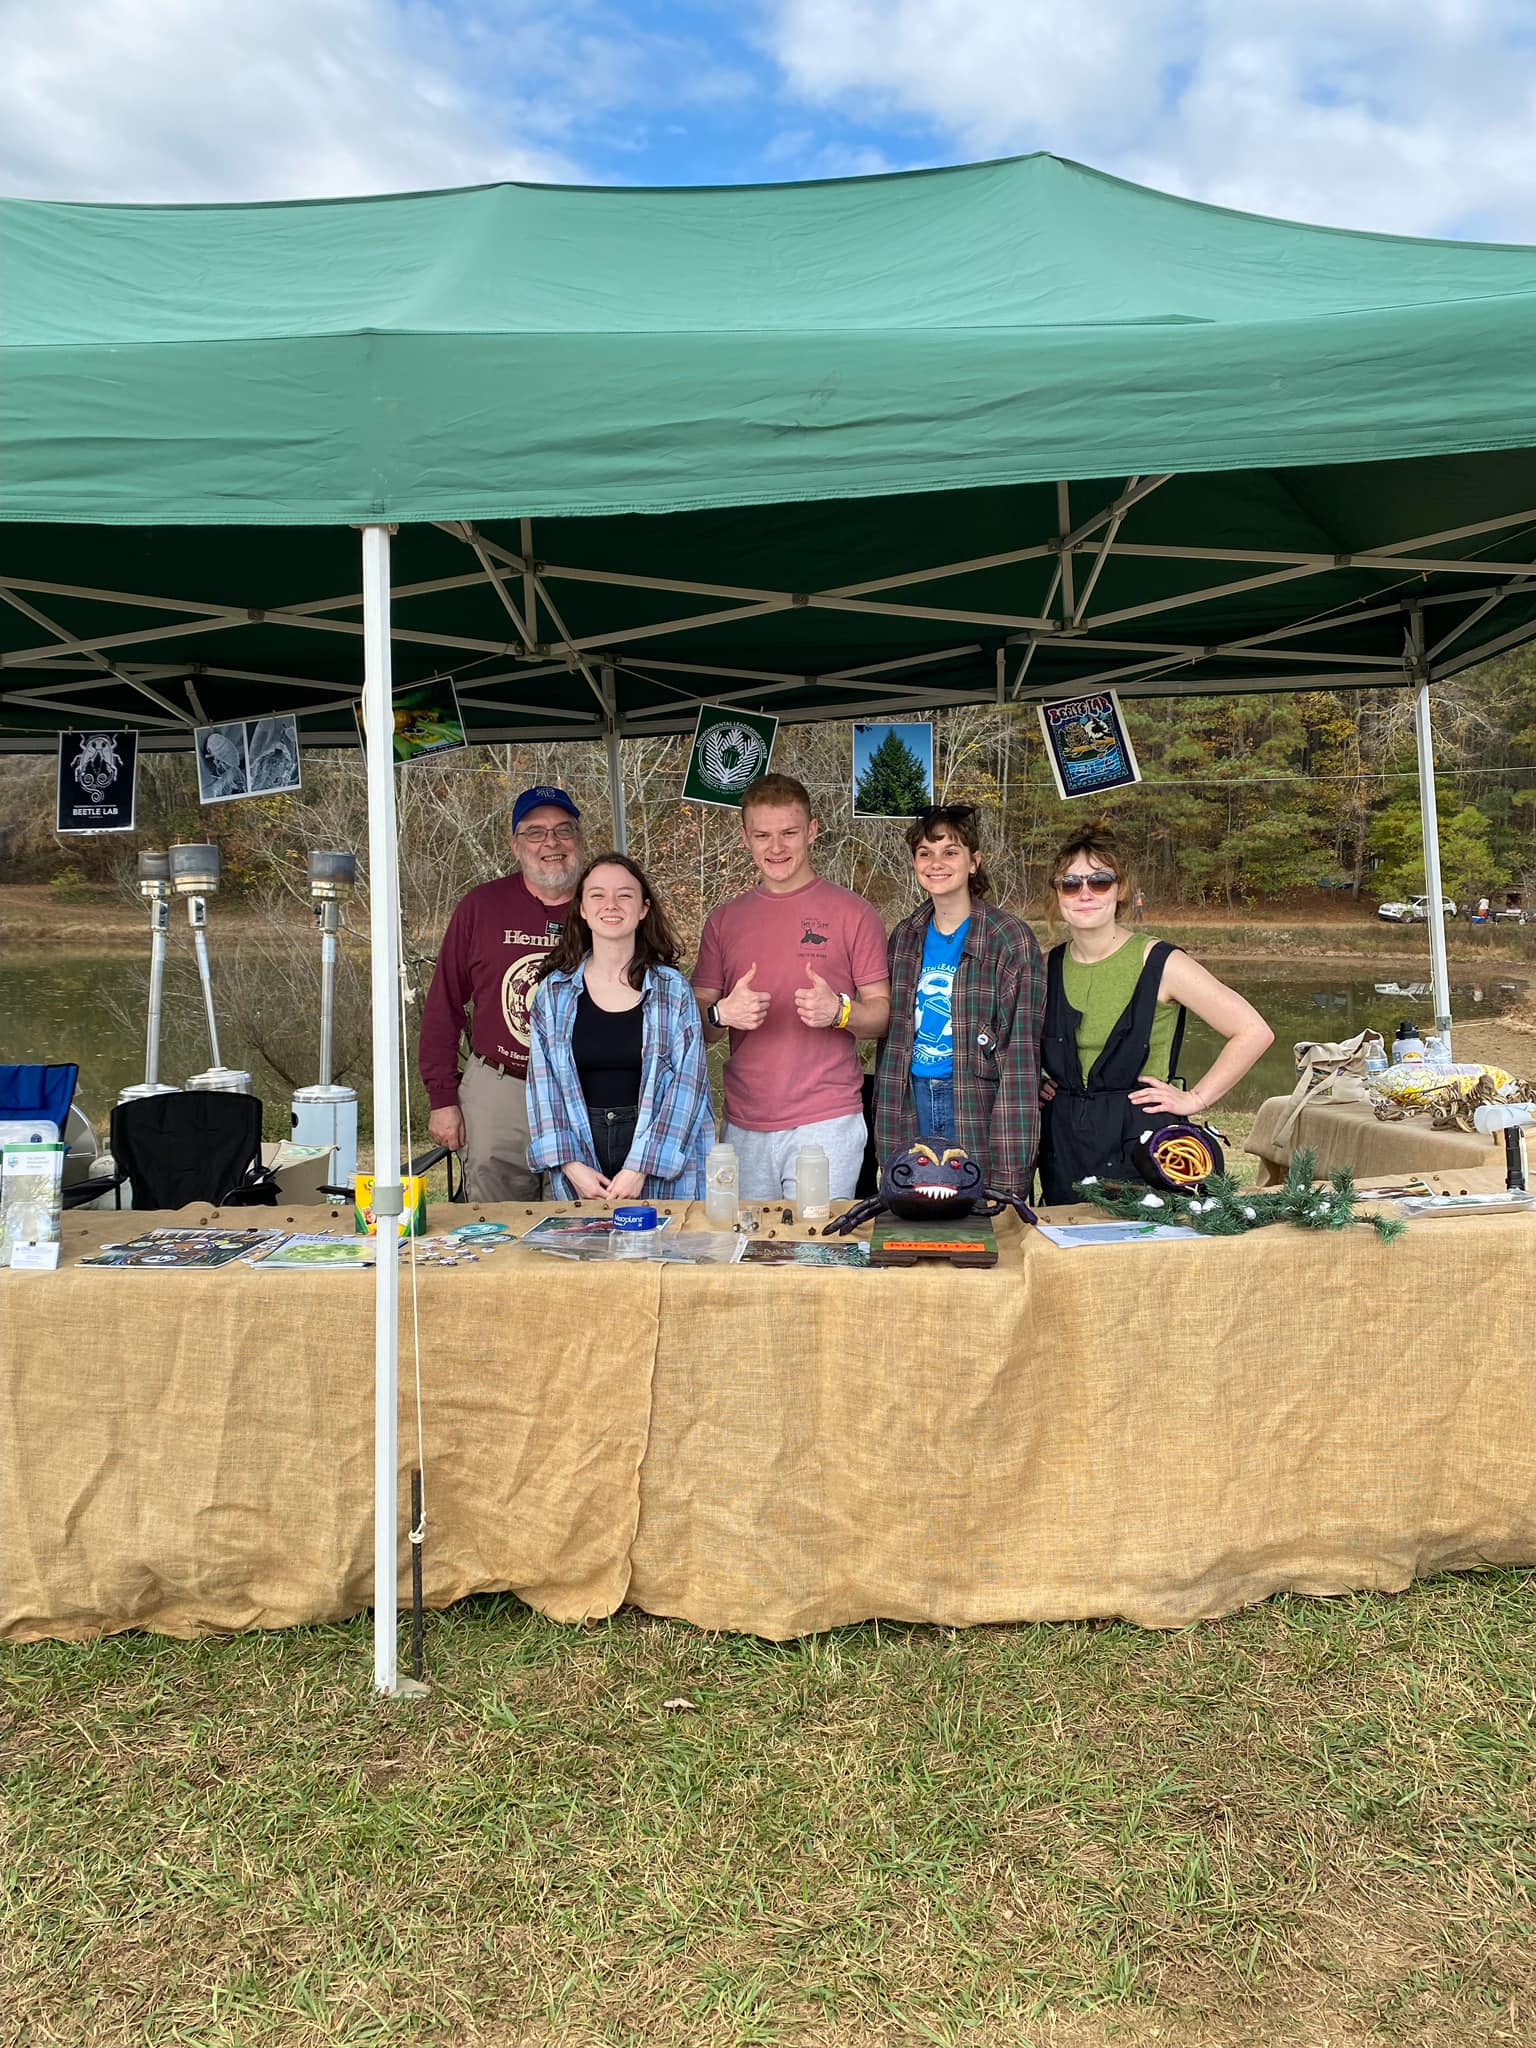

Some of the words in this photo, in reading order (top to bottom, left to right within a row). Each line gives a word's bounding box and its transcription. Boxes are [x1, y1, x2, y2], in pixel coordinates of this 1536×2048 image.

[72, 808, 101, 816] BEETLE
[102, 807, 119, 815] LAB
[497, 1045, 509, 1057] The
